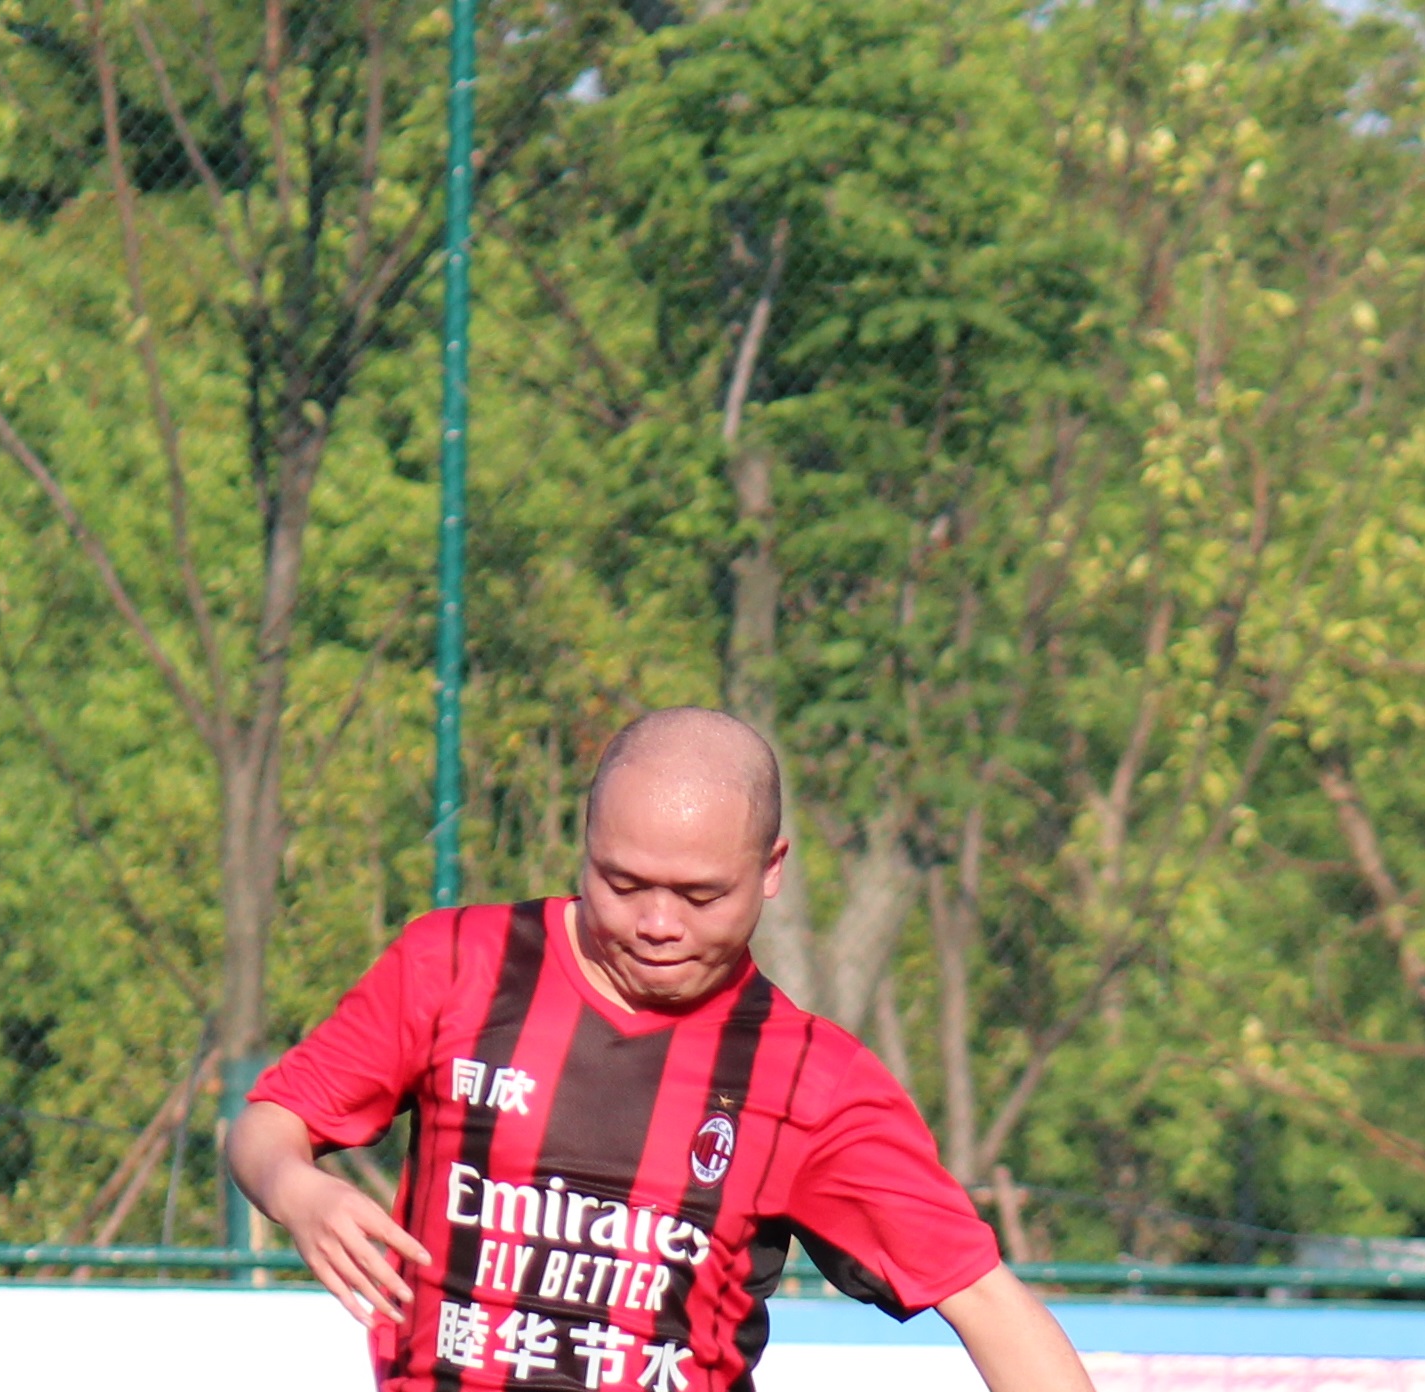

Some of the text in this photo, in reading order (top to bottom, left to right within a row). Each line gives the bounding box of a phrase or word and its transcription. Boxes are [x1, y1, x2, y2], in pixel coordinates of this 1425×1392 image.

[451, 1057, 536, 1116] 同欣
[446, 1161, 711, 1266] Emirates
[475, 1240, 671, 1311] FLY BETTER
